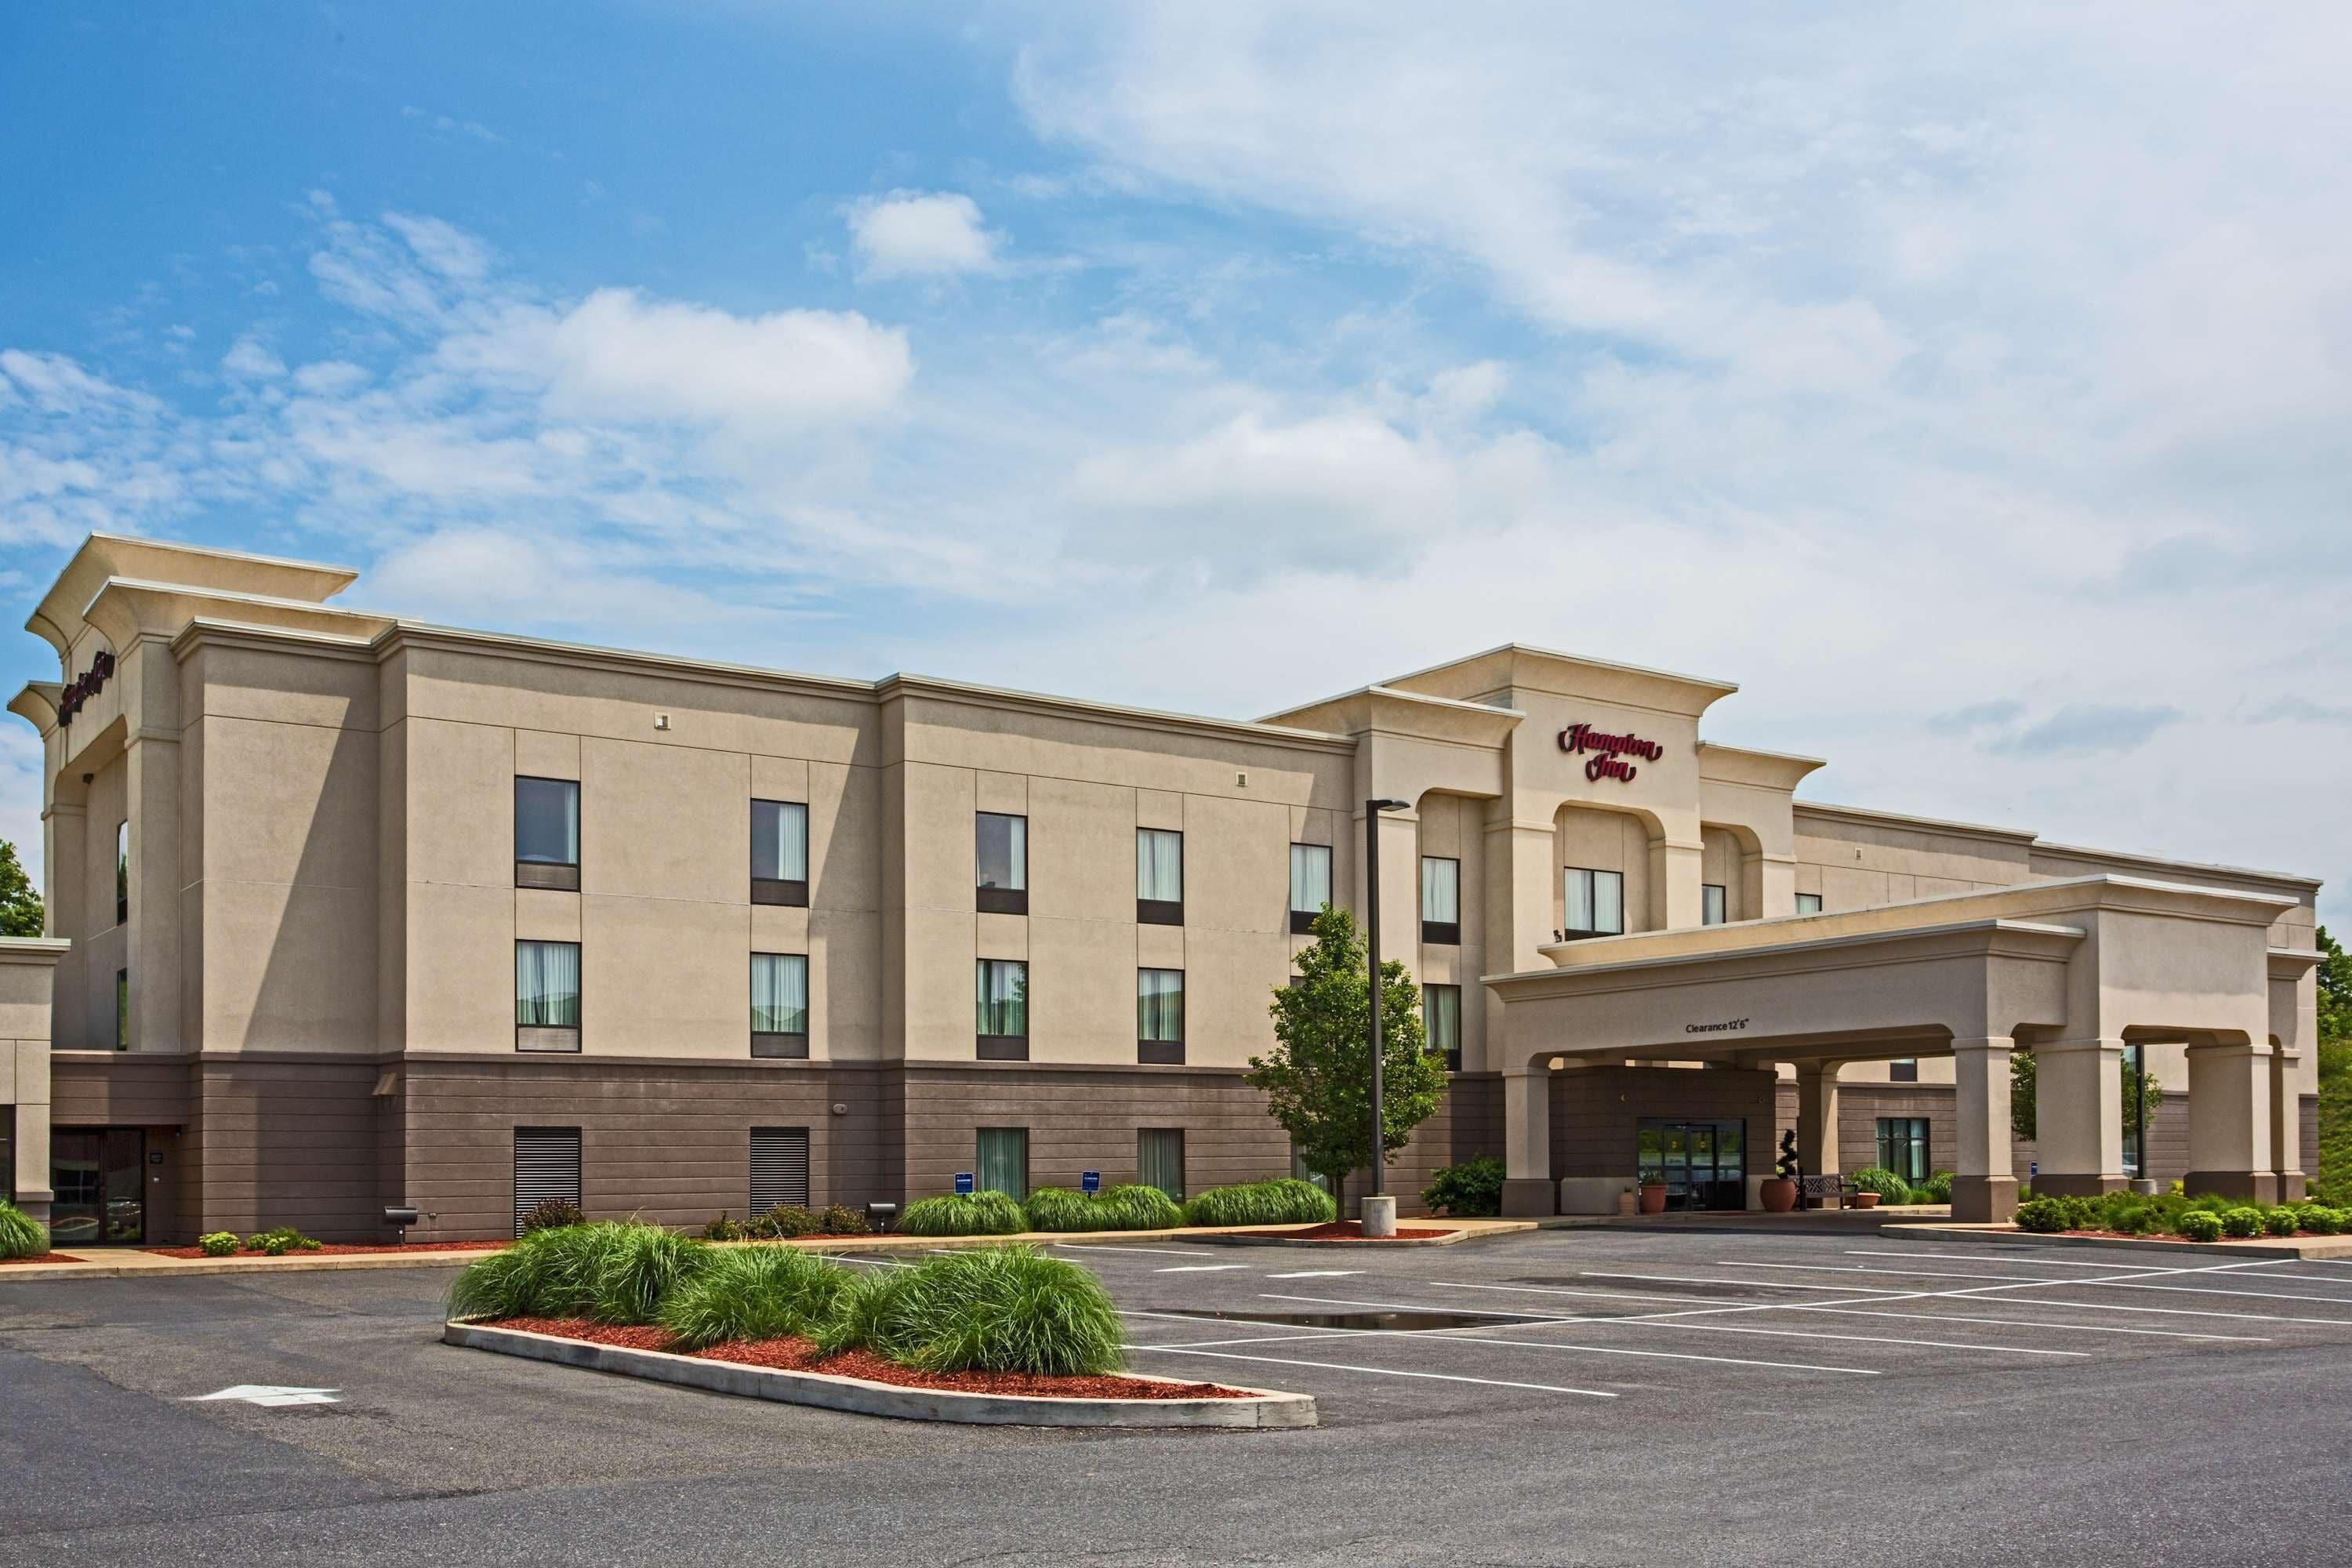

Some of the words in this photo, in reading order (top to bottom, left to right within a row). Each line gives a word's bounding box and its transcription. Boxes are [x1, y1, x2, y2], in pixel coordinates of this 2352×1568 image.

[1558, 724, 1663, 761] Hampton
[1585, 753, 1637, 782] Inn
[1686, 1022, 1727, 1033] Clearance
